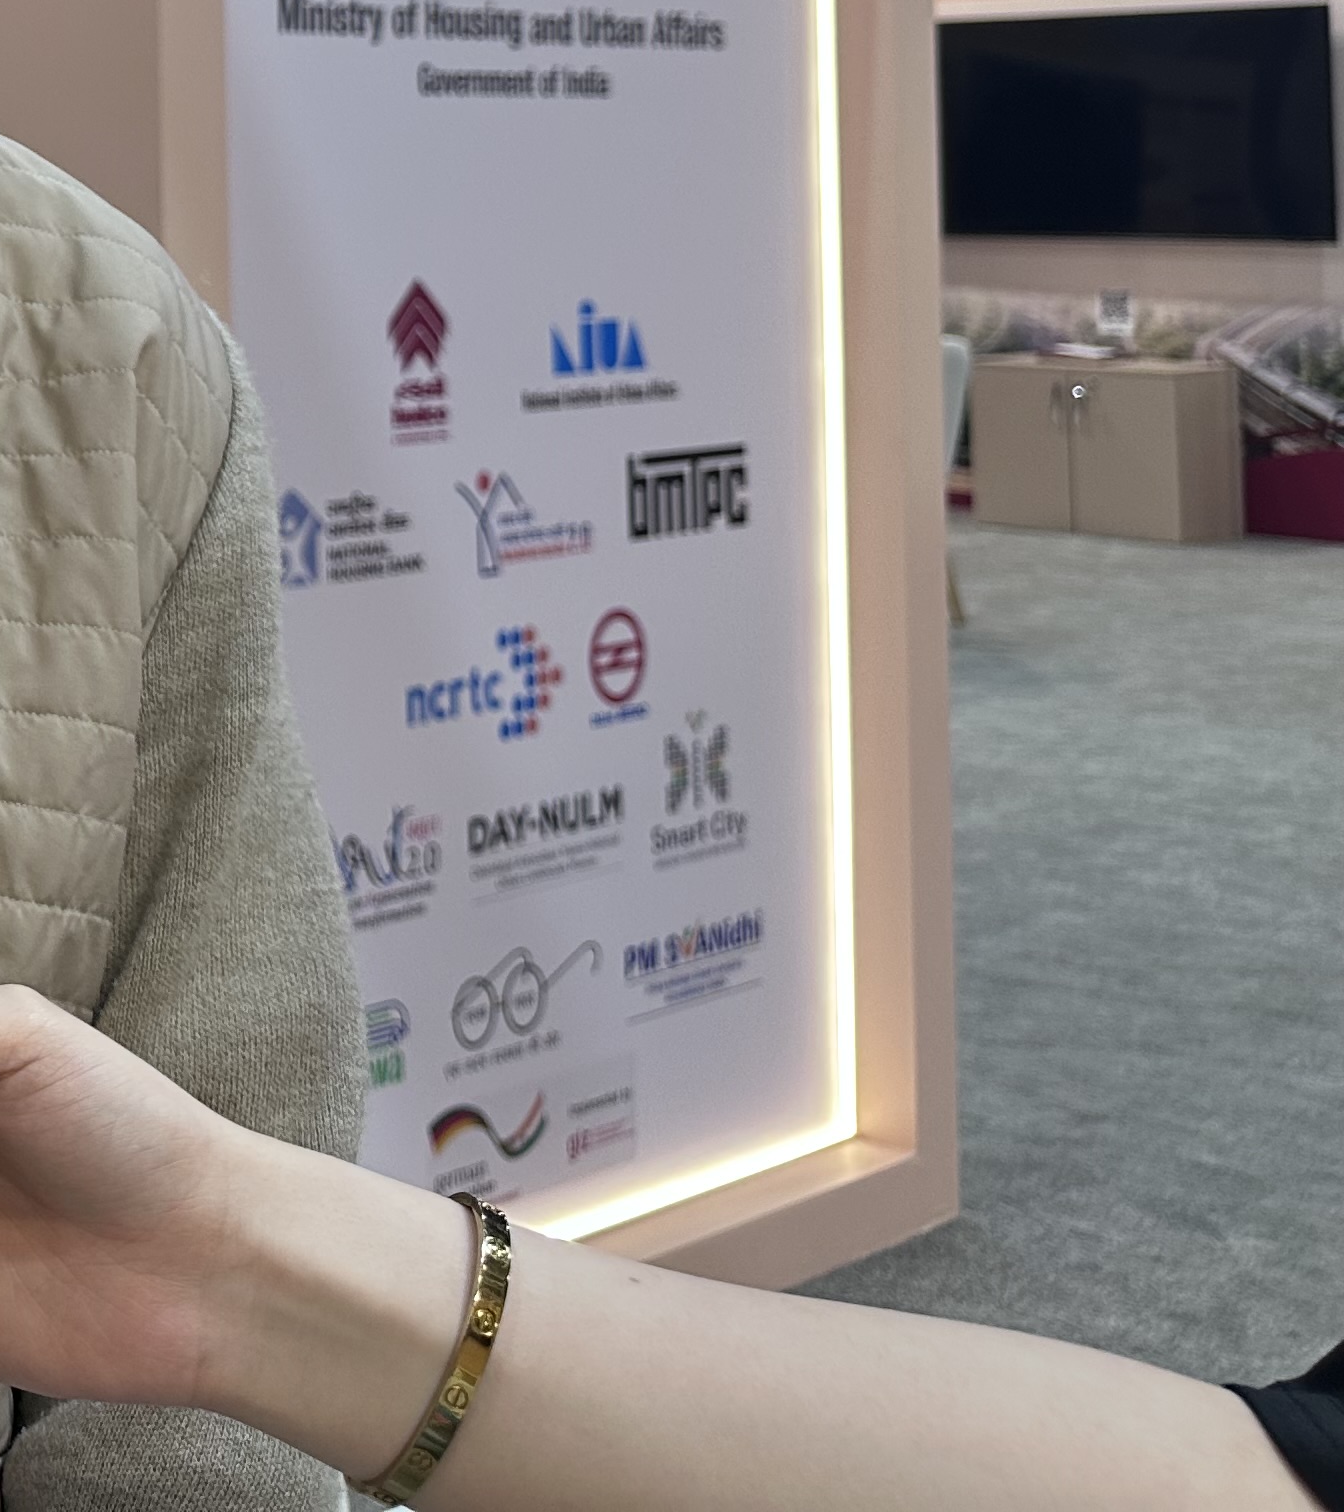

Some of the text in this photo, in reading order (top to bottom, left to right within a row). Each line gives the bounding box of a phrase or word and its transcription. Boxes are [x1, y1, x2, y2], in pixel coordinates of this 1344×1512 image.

[528, 6, 573, 47] and
[577, 6, 646, 49] Urban
[650, 8, 727, 52] Affairs
[417, 60, 611, 100] Government of India
[406, 666, 503, 729] ncrtc
[466, 782, 625, 858] DAY-NULM
[650, 817, 709, 857] Smart
[710, 807, 748, 838] City
[623, 938, 659, 981] PM
